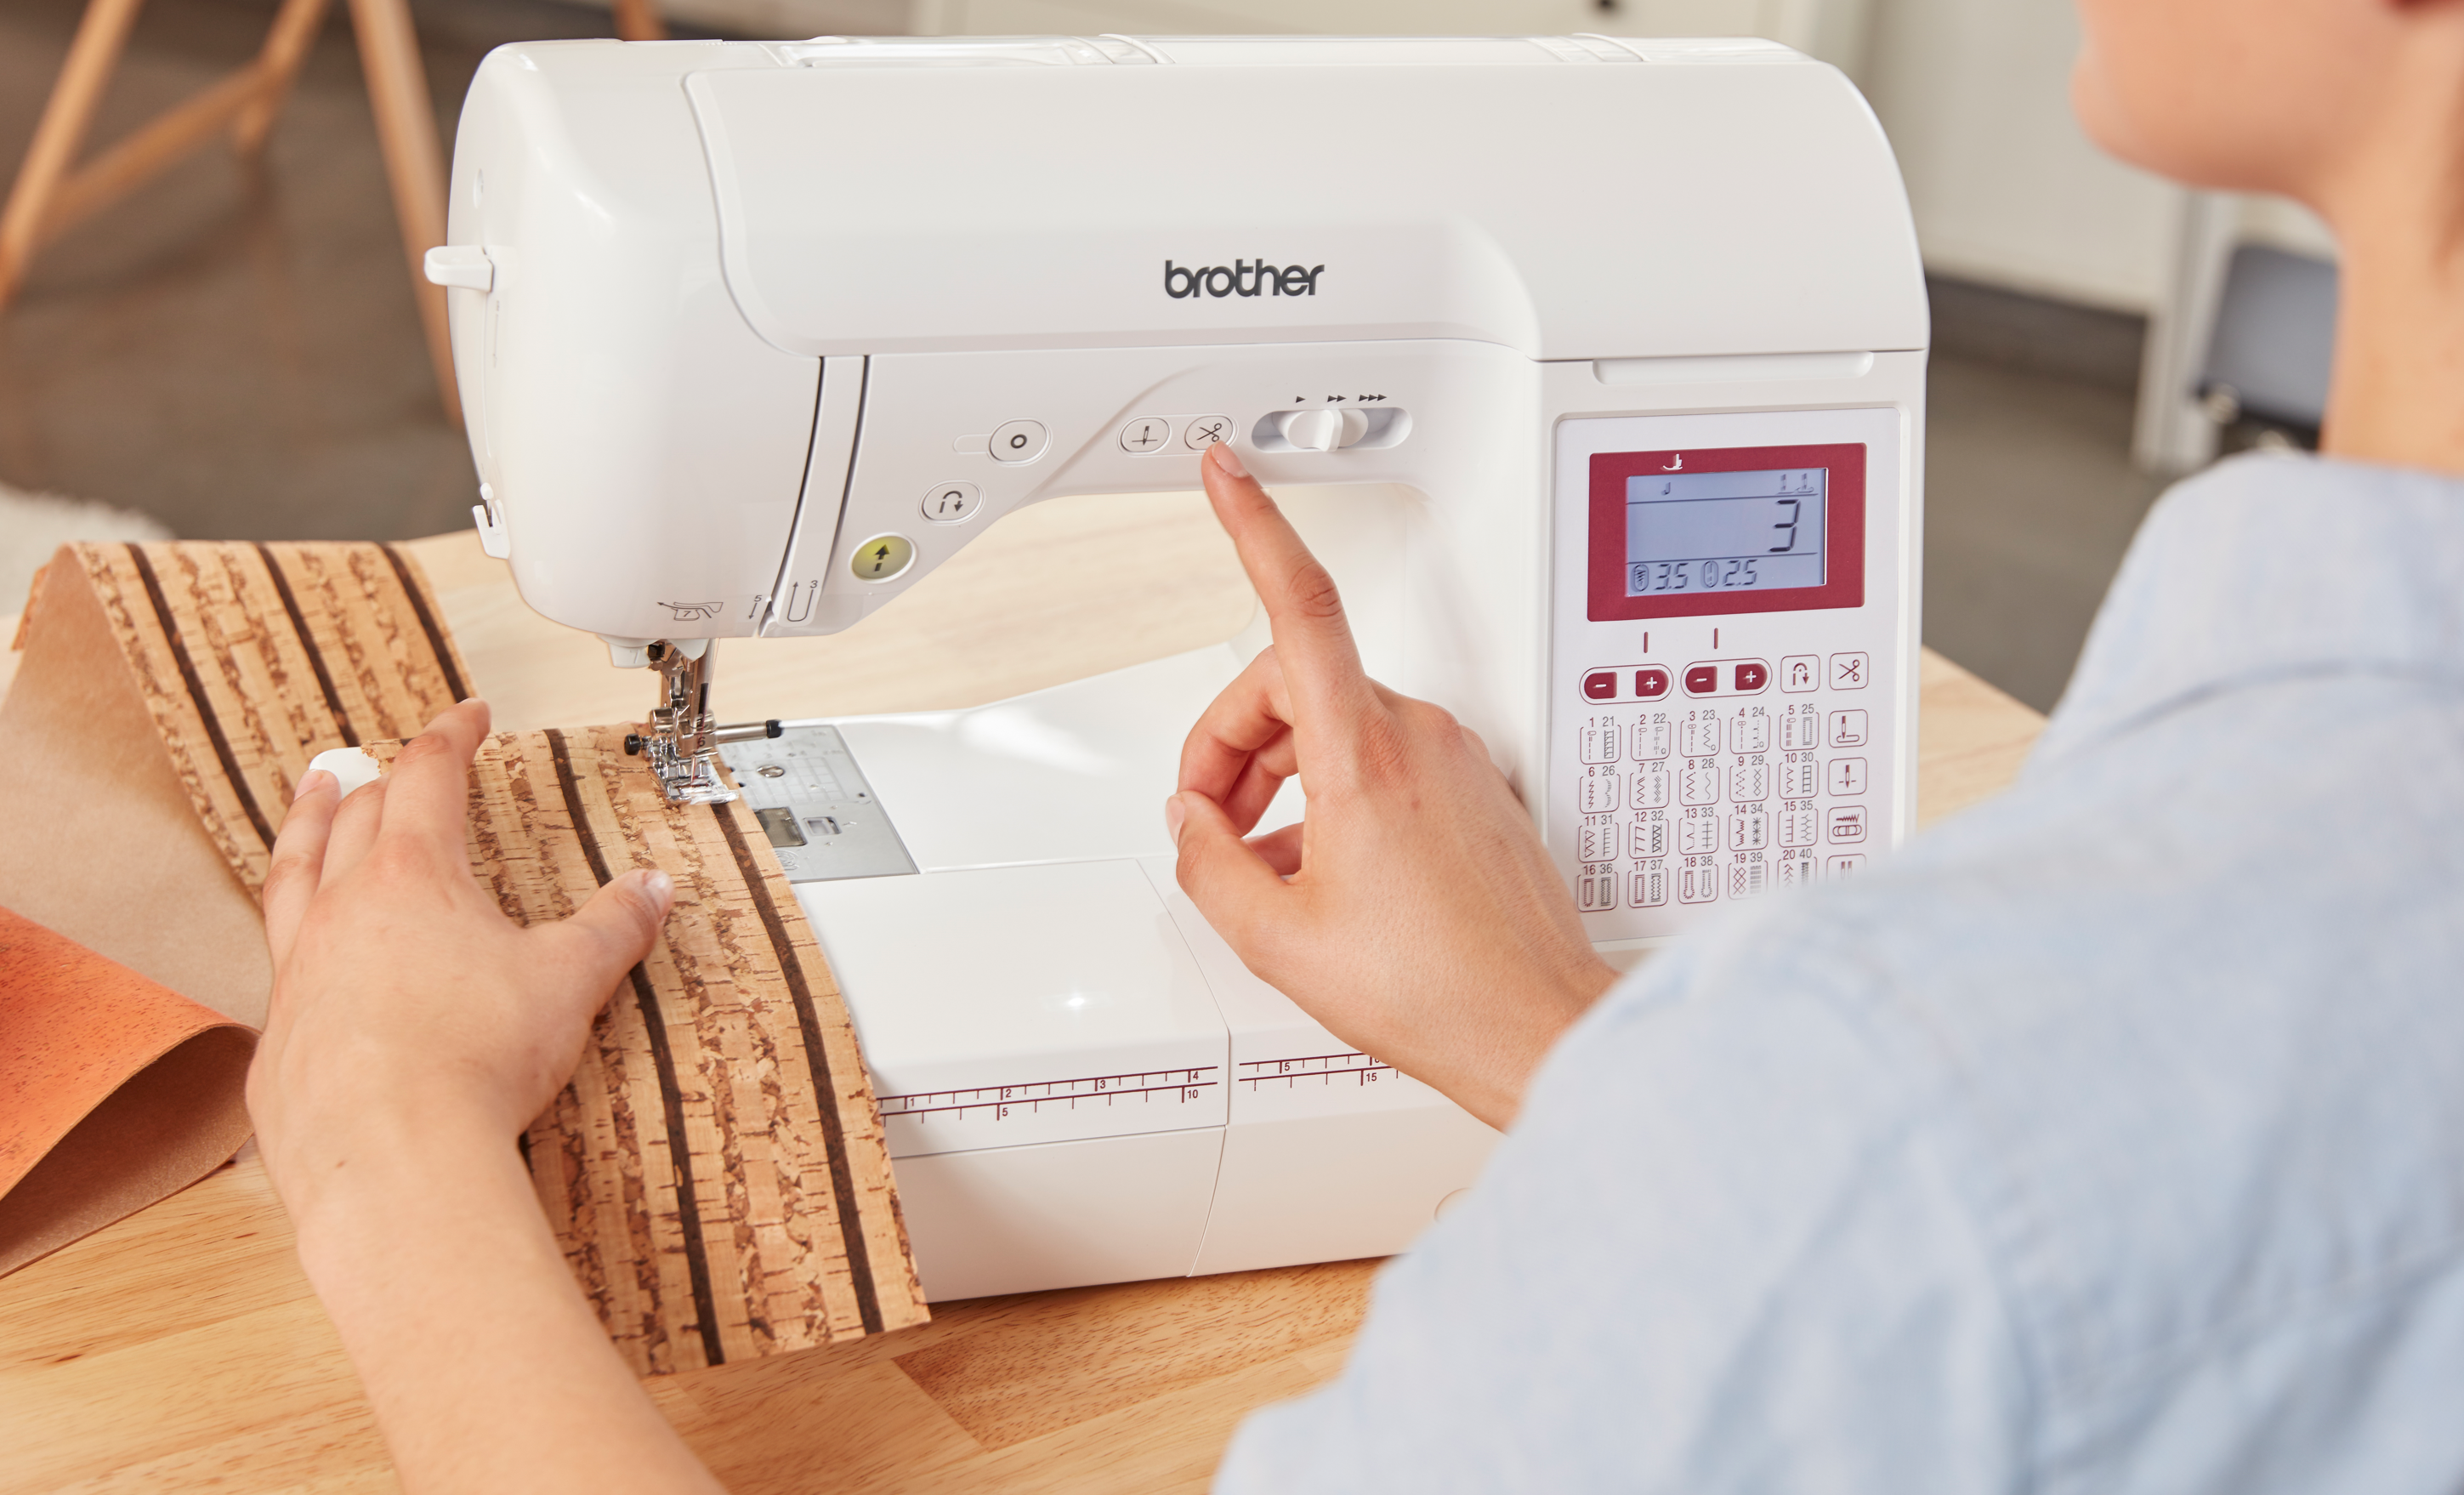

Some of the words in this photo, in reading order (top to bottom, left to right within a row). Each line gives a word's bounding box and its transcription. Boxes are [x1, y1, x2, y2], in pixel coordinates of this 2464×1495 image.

[1165, 259, 1325, 298] brother
[1769, 498, 1801, 553] 3
[1655, 562, 1689, 590] 3.5
[1723, 558, 1758, 587] 2.5
[809, 580, 819, 589] 3
[753, 594, 763, 603] 5
[1689, 711, 1696, 722] 3
[1702, 709, 1716, 721] 23
[1738, 708, 1746, 718] 4
[1751, 707, 1765, 718] 24
[1788, 705, 1795, 715] 5
[1801, 704, 1814, 715] 25
[1589, 717, 1594, 728] 1
[1602, 716, 1615, 727] 21
[1639, 714, 1647, 725] 2
[1653, 713, 1666, 725] 22
[1738, 756, 1745, 767] 9
[1751, 755, 1764, 766] 29
[1785, 753, 1797, 764] 10
[1801, 752, 1814, 763] 30
[1638, 763, 1645, 774] 7
[1651, 762, 1665, 773] 27
[1688, 759, 1695, 770] 8
[1701, 759, 1715, 770] 28
[1588, 767, 1595, 777] 6
[1602, 765, 1615, 776] 26
[1734, 804, 1747, 816] 14
[1750, 804, 1763, 815] 34
[1784, 801, 1797, 812] 15
[1800, 800, 1814, 811] 35
[1634, 811, 1647, 822] 12
[1650, 810, 1664, 821] 32
[1684, 808, 1698, 819] 13
[1700, 807, 1714, 818] 33
[1584, 816, 1596, 827] 11
[1600, 815, 1613, 826] 31
[1734, 853, 1746, 864] 19
[1750, 852, 1763, 863] 39
[1782, 850, 1796, 861] 20
[1798, 849, 1813, 859] 40
[1633, 861, 1647, 872] 17
[1649, 860, 1664, 871] 37
[1684, 857, 1697, 867] 18
[1700, 856, 1713, 867] 38
[1583, 865, 1596, 876] 16
[1599, 863, 1613, 875] 36
[1284, 1062, 1291, 1072] 5
[1365, 1072, 1377, 1083] 15
[910, 1098, 916, 1107] 1
[1005, 1089, 1012, 1099] 2
[1099, 1080, 1106, 1089] 3
[1192, 1071, 1200, 1080] 4
[1002, 1107, 1008, 1117] 5
[1187, 1089, 1199, 1100] 10
